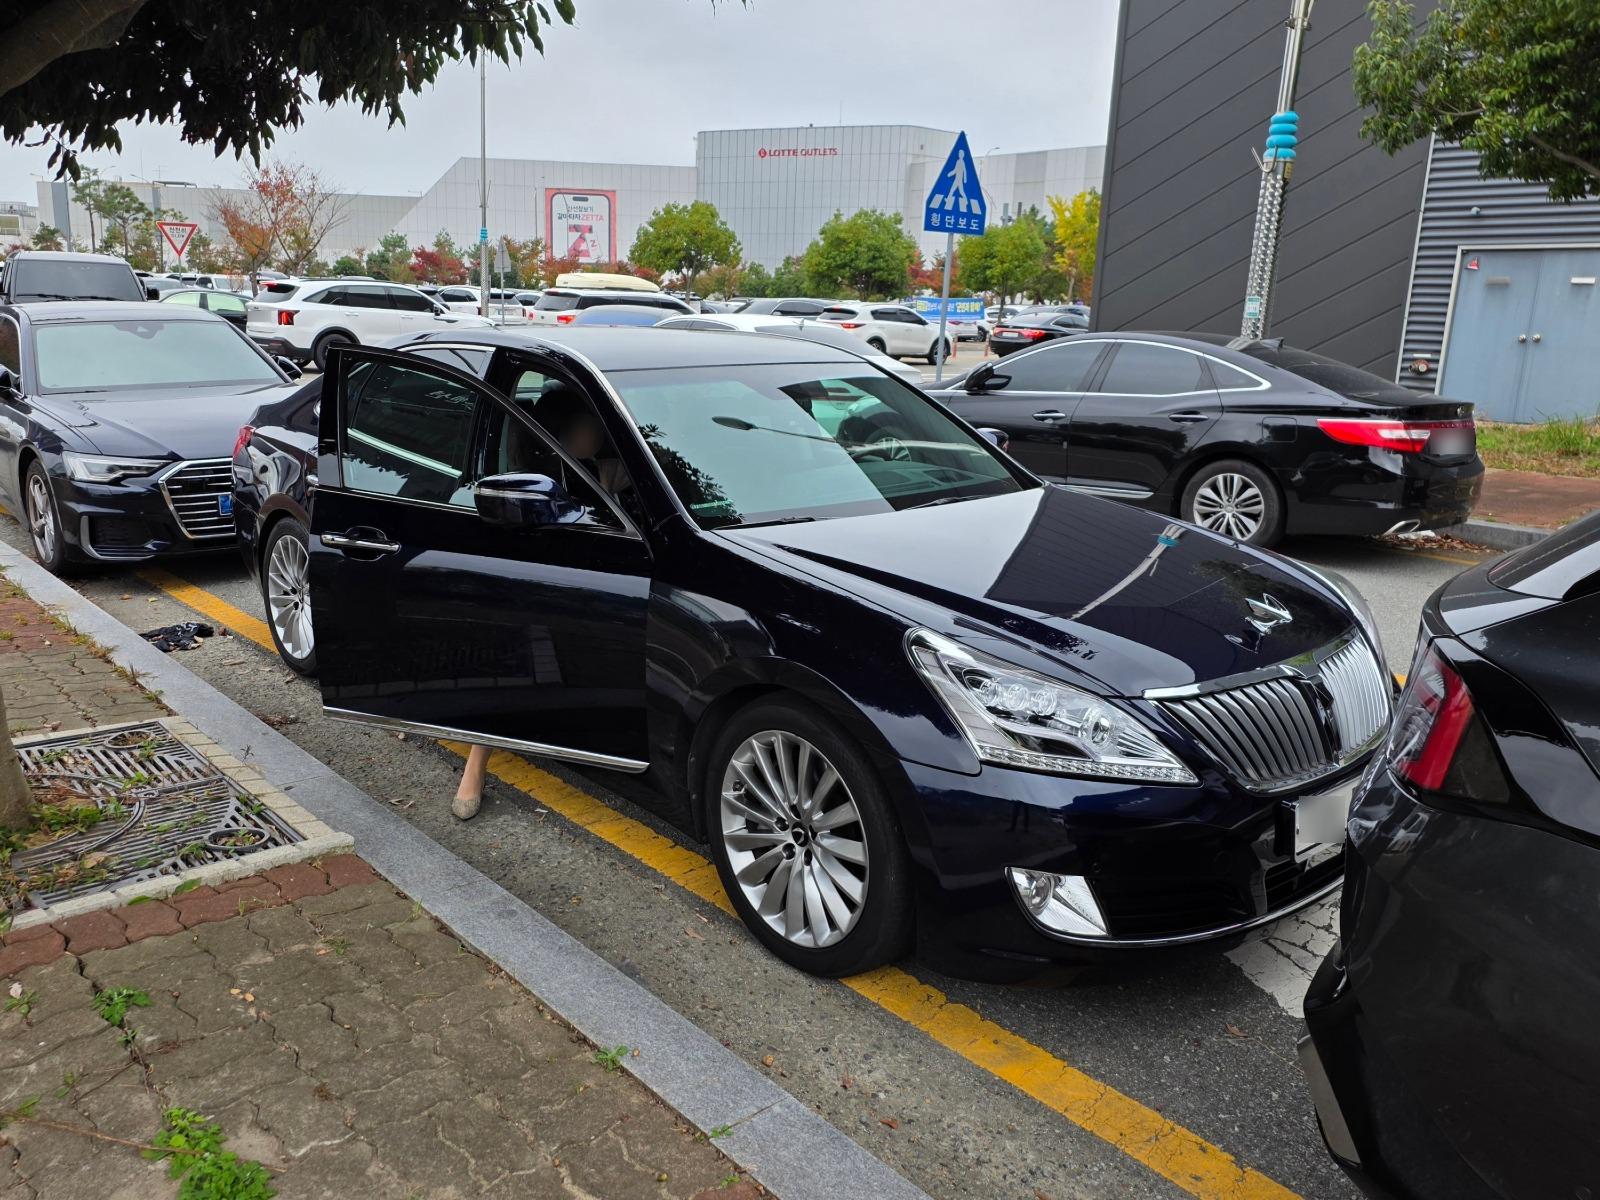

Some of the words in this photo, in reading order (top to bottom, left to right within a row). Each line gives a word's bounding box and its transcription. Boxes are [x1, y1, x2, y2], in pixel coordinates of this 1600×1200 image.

[768, 149, 798, 157] LOTTE
[800, 147, 838, 156] OUTLETS
[930, 212, 980, 230] 횡단보도
